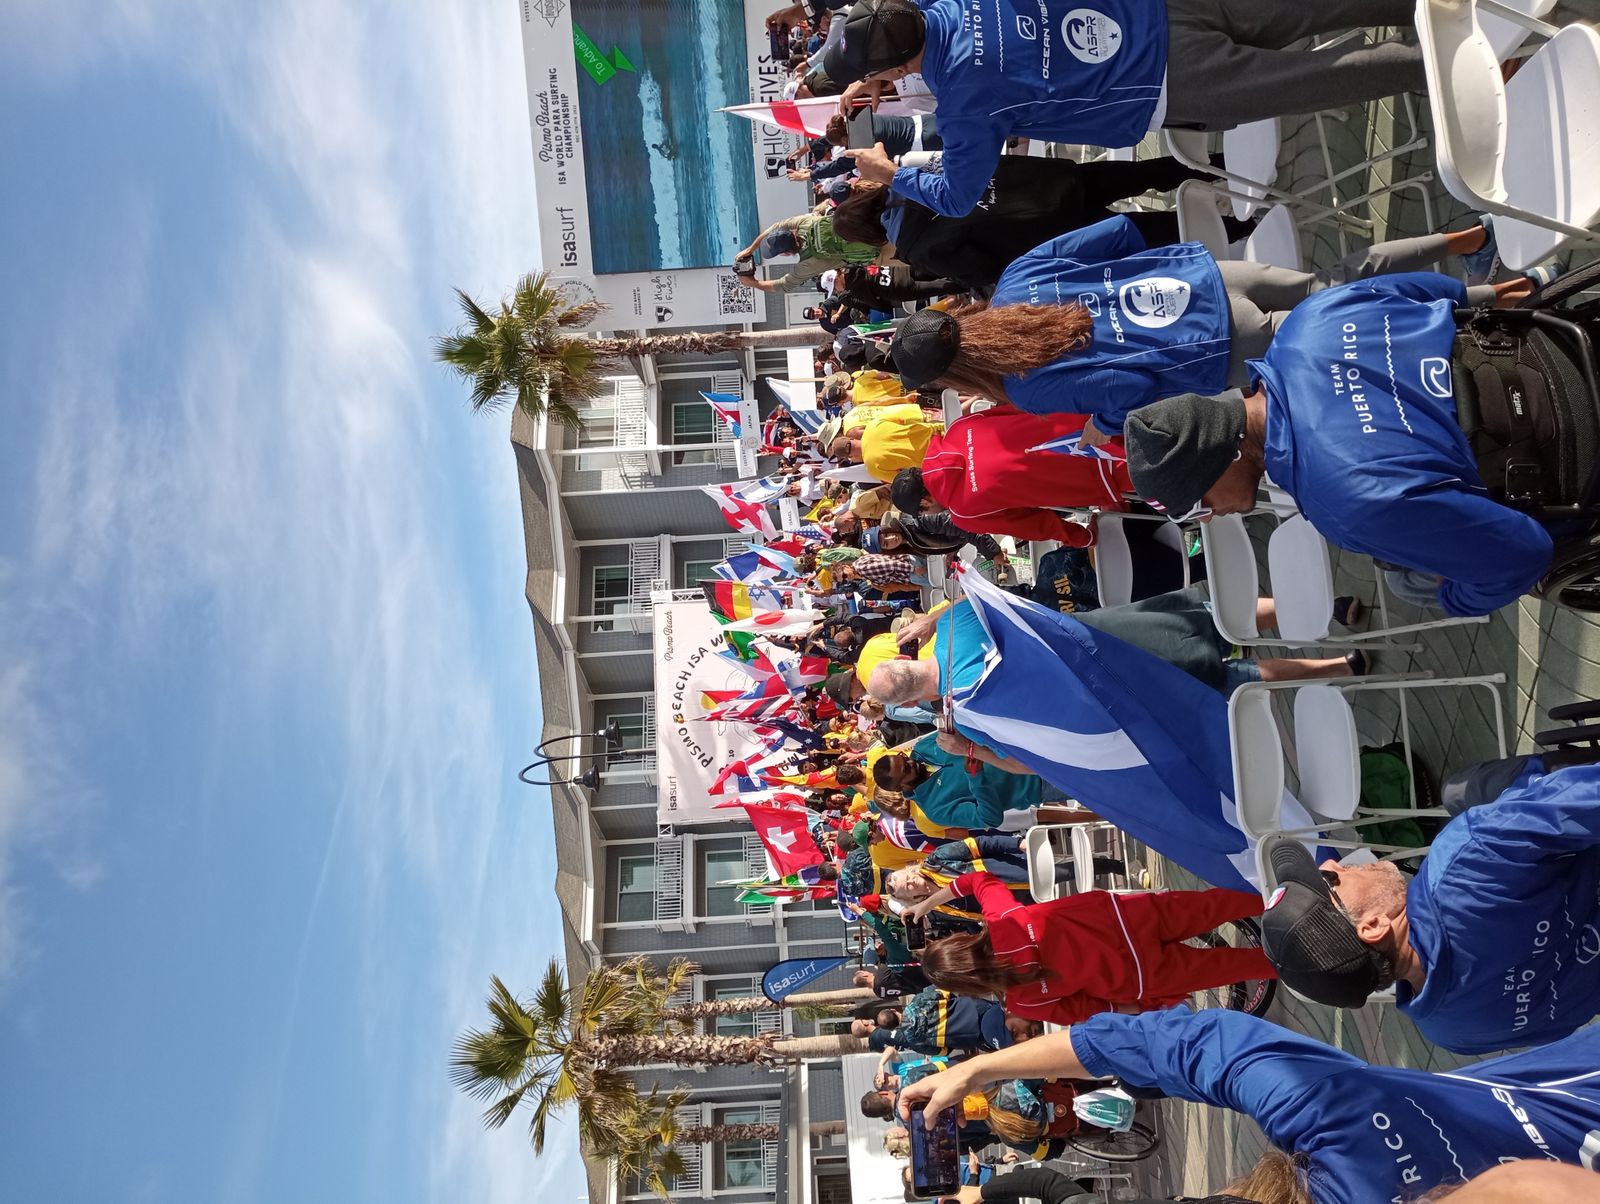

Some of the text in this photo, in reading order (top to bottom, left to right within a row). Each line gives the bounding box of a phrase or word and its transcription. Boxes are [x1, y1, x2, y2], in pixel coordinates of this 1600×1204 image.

[573, 31, 606, 76] To Advanc
[972, 0, 984, 66] PUERTO RI
[1037, 0, 1050, 79] OCEAN VIBE
[1086, 16, 1098, 57] ASPR
[535, 90, 554, 163] Pismo Beach
[548, 67, 568, 185] ISA WORLD PARA SURFING
[560, 92, 574, 158] CHAMPIONSHIP
[758, 54, 782, 156] HIG FIVES
[556, 206, 578, 266] isasurf
[651, 275, 666, 301] High
[1330, 363, 1344, 396] TEAM
[1342, 322, 1377, 434] PUERTO RICO
[970, 472, 978, 492] Swiss
[663, 610, 674, 661] Pismo Beach
[672, 646, 714, 768] PISMO BEACH ISA
[667, 776, 678, 811] isasurf
[1532, 920, 1550, 958] ICO
[768, 960, 816, 994] isasurf
[1372, 1112, 1422, 1184] RICO
